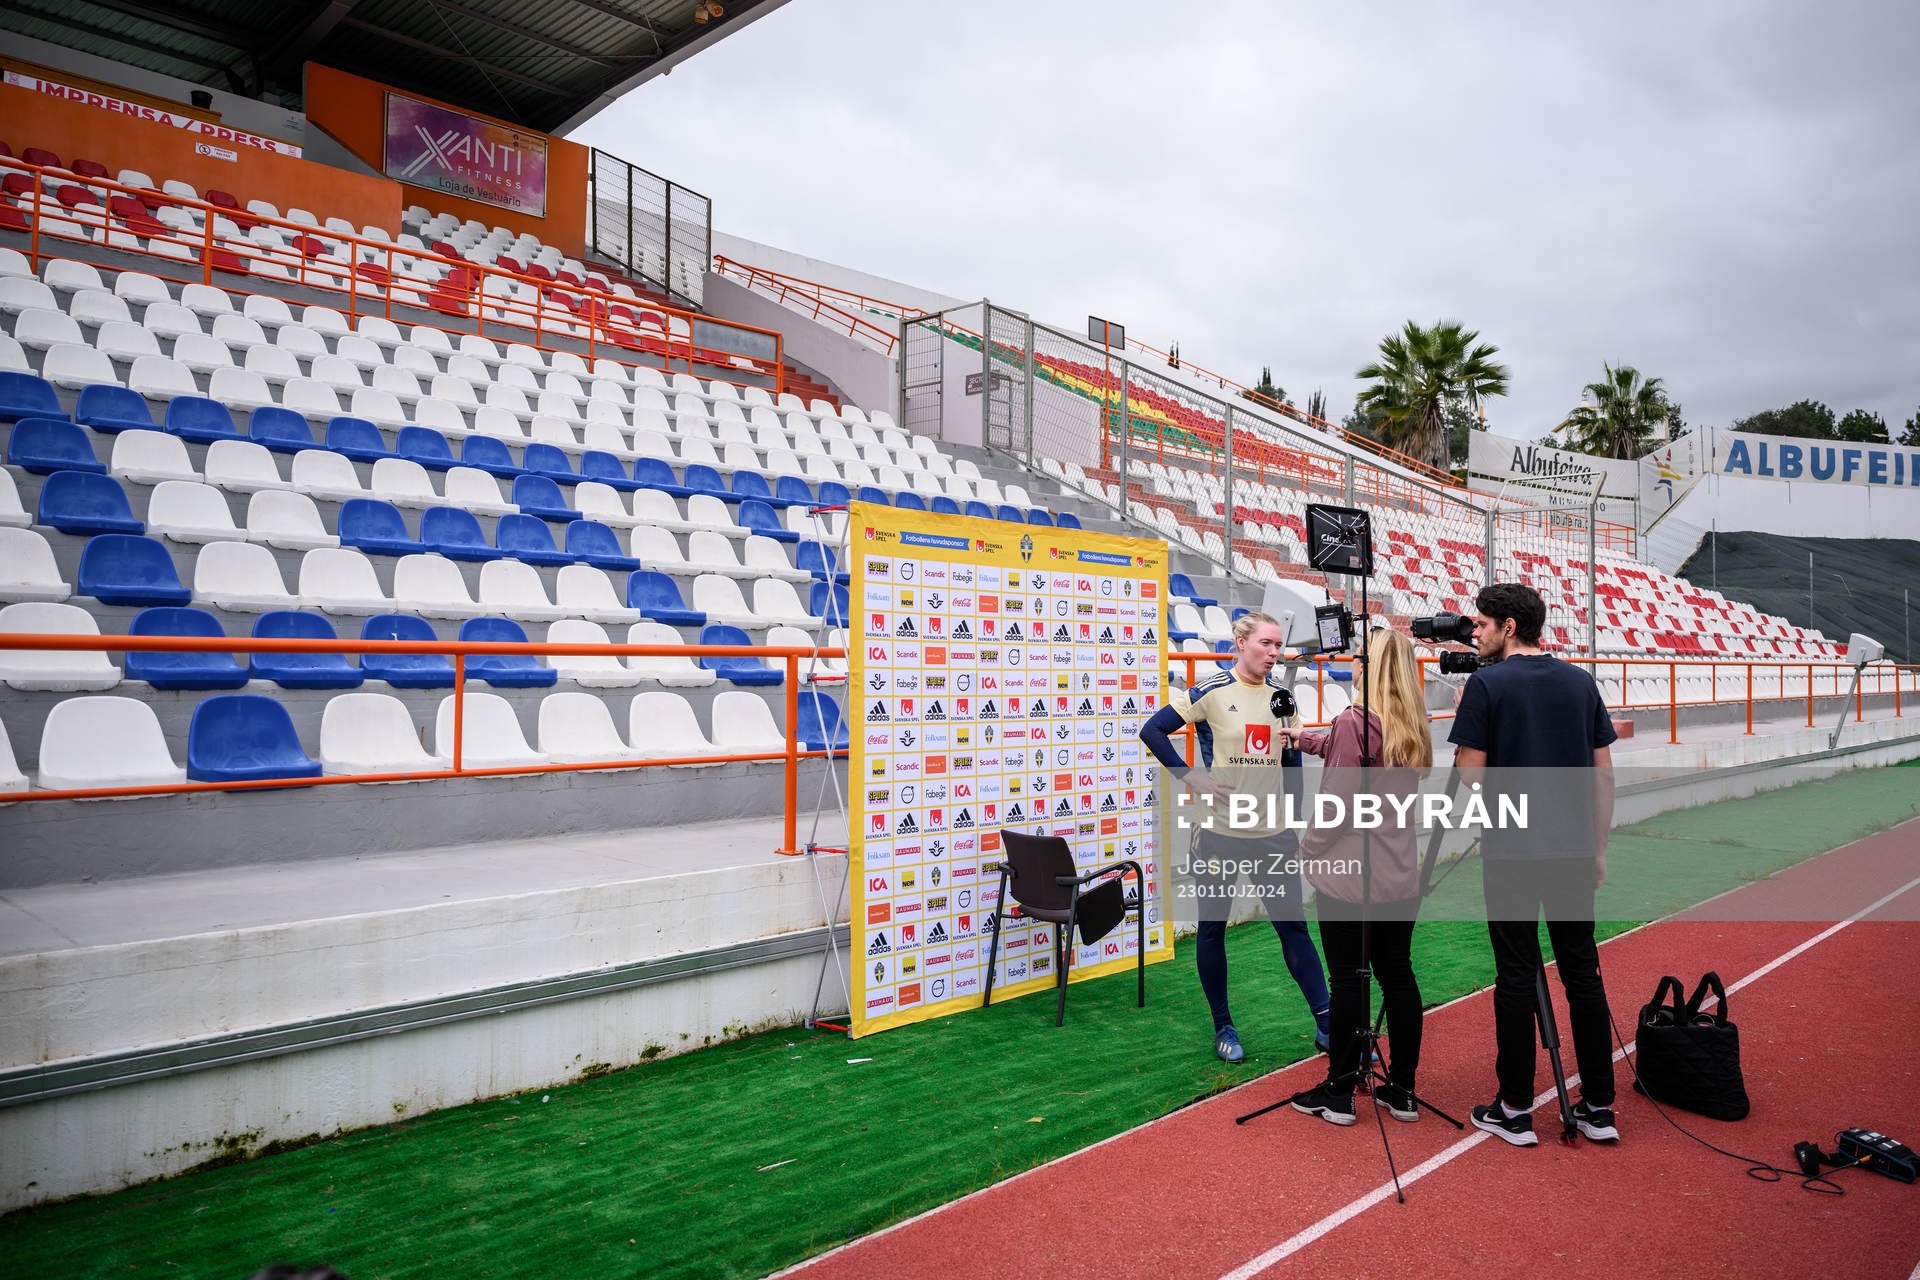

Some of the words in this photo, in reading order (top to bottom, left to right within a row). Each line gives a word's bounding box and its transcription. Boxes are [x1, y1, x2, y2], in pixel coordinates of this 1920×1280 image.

[36, 80, 174, 128] IMPRENSA
[200, 122, 276, 152] PRESS
[401, 124, 522, 178] XANTI
[458, 166, 521, 190] FITNESS
[440, 177, 460, 192] Loja
[463, 184, 474, 195] de
[478, 186, 521, 207] Vestuário
[906, 535, 930, 544] Fotbollens
[953, 572, 972, 583] Fabege
[896, 629, 918, 637] adidas
[869, 647, 887, 660] ICA
[897, 678, 917, 690] Fabege
[982, 677, 997, 689] ICA
[1271, 697, 1282, 709] svt
[1032, 728, 1046, 739] ICA
[896, 762, 919, 770] Scandic
[926, 788, 946, 799] Fabege
[955, 784, 971, 797] ICA
[897, 825, 919, 834] adidas
[954, 819, 974, 828] adidas
[933, 839, 939, 848] SJ
[870, 878, 888, 892] ICA
[927, 933, 948, 944] adidas
[1034, 933, 1048, 946] ICA
[868, 944, 891, 956] adidas
[955, 978, 975, 988] Scandic
